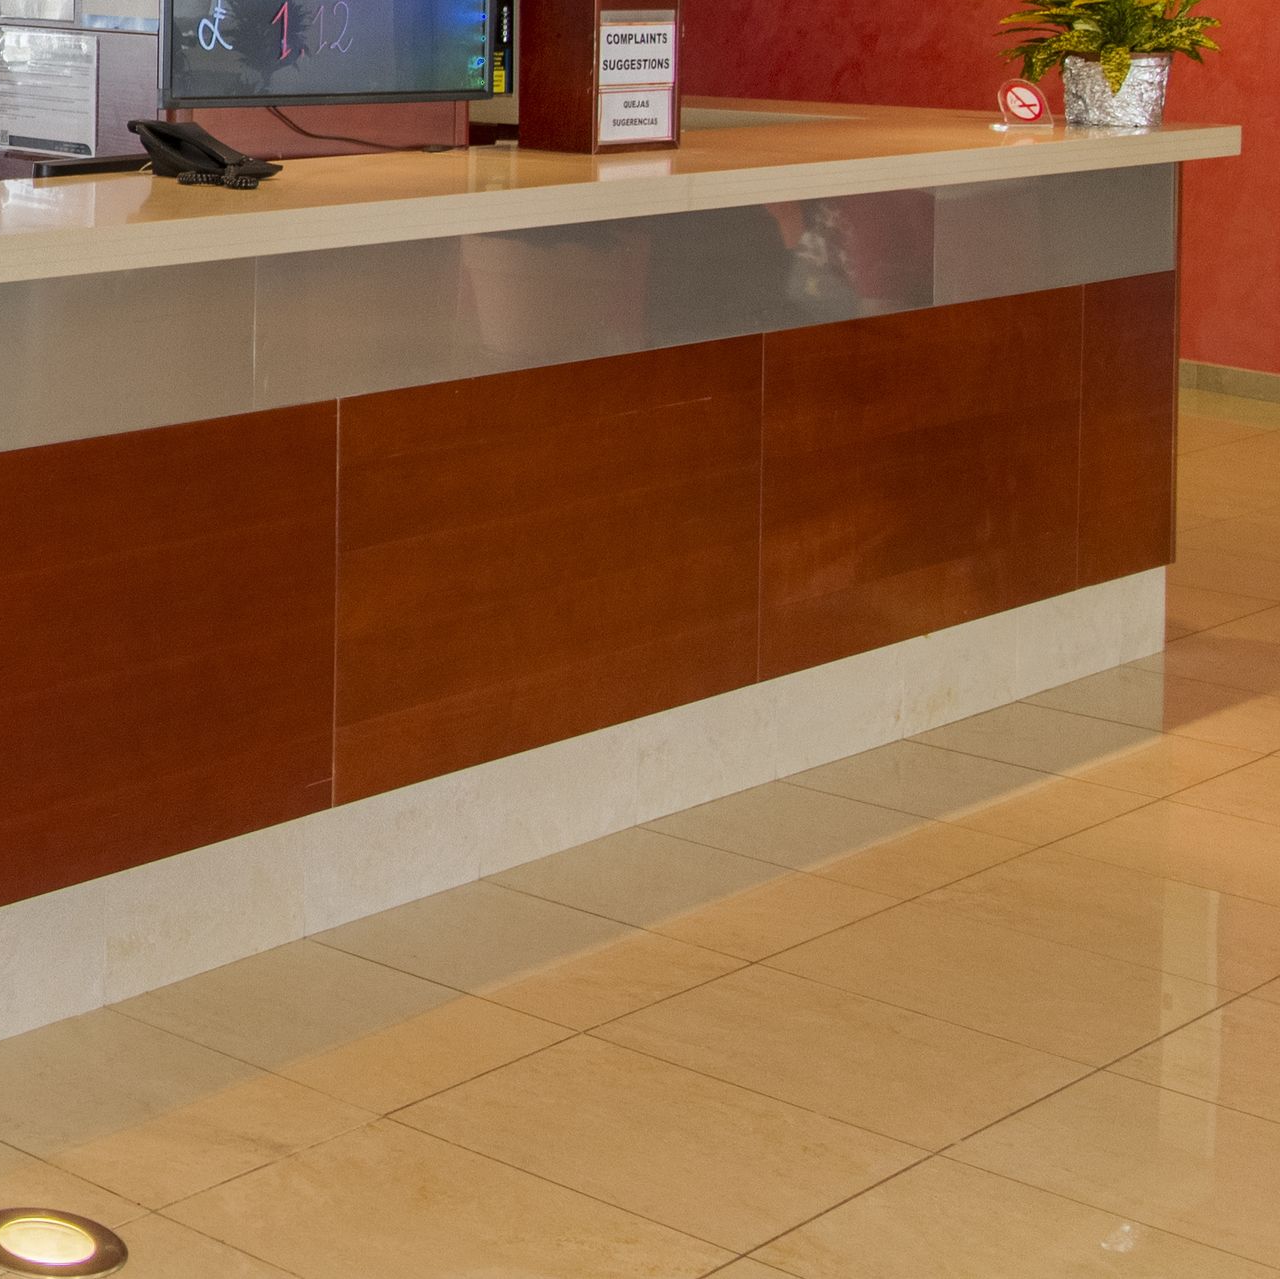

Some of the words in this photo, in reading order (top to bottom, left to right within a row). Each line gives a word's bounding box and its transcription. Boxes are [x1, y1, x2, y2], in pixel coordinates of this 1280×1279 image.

[606, 33, 668, 45] COMPLAINTS
[602, 58, 670, 71] SUGGESTIONS
[623, 100, 650, 109] QUEJAS
[612, 117, 658, 127] SUGERENCIAS
